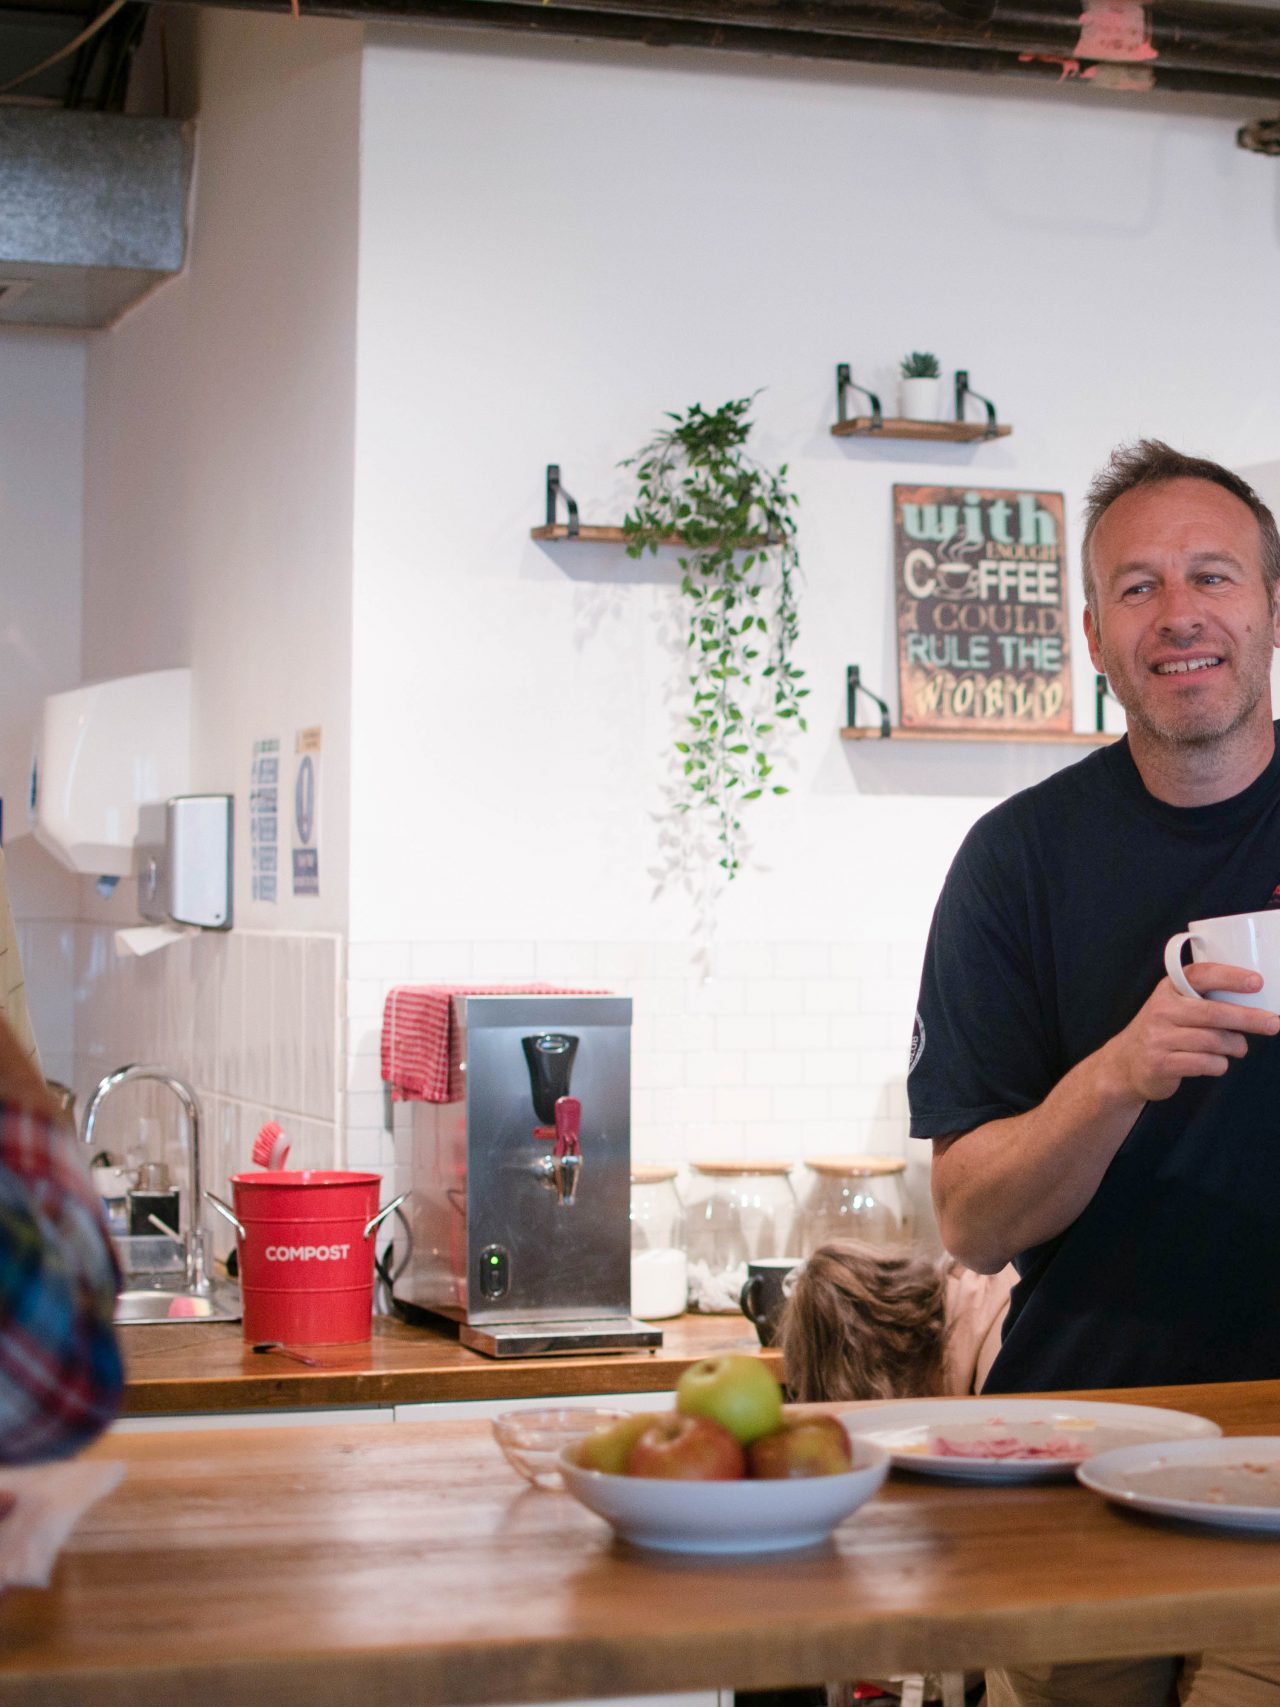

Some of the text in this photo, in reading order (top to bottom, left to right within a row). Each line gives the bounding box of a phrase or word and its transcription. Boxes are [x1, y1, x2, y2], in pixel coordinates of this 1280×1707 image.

[902, 490, 1058, 545] with
[932, 602, 1062, 636] COULD
[906, 633, 1063, 672] RULE THE
[914, 671, 1064, 719] WORLD
[265, 1244, 350, 1262] COMPOST
